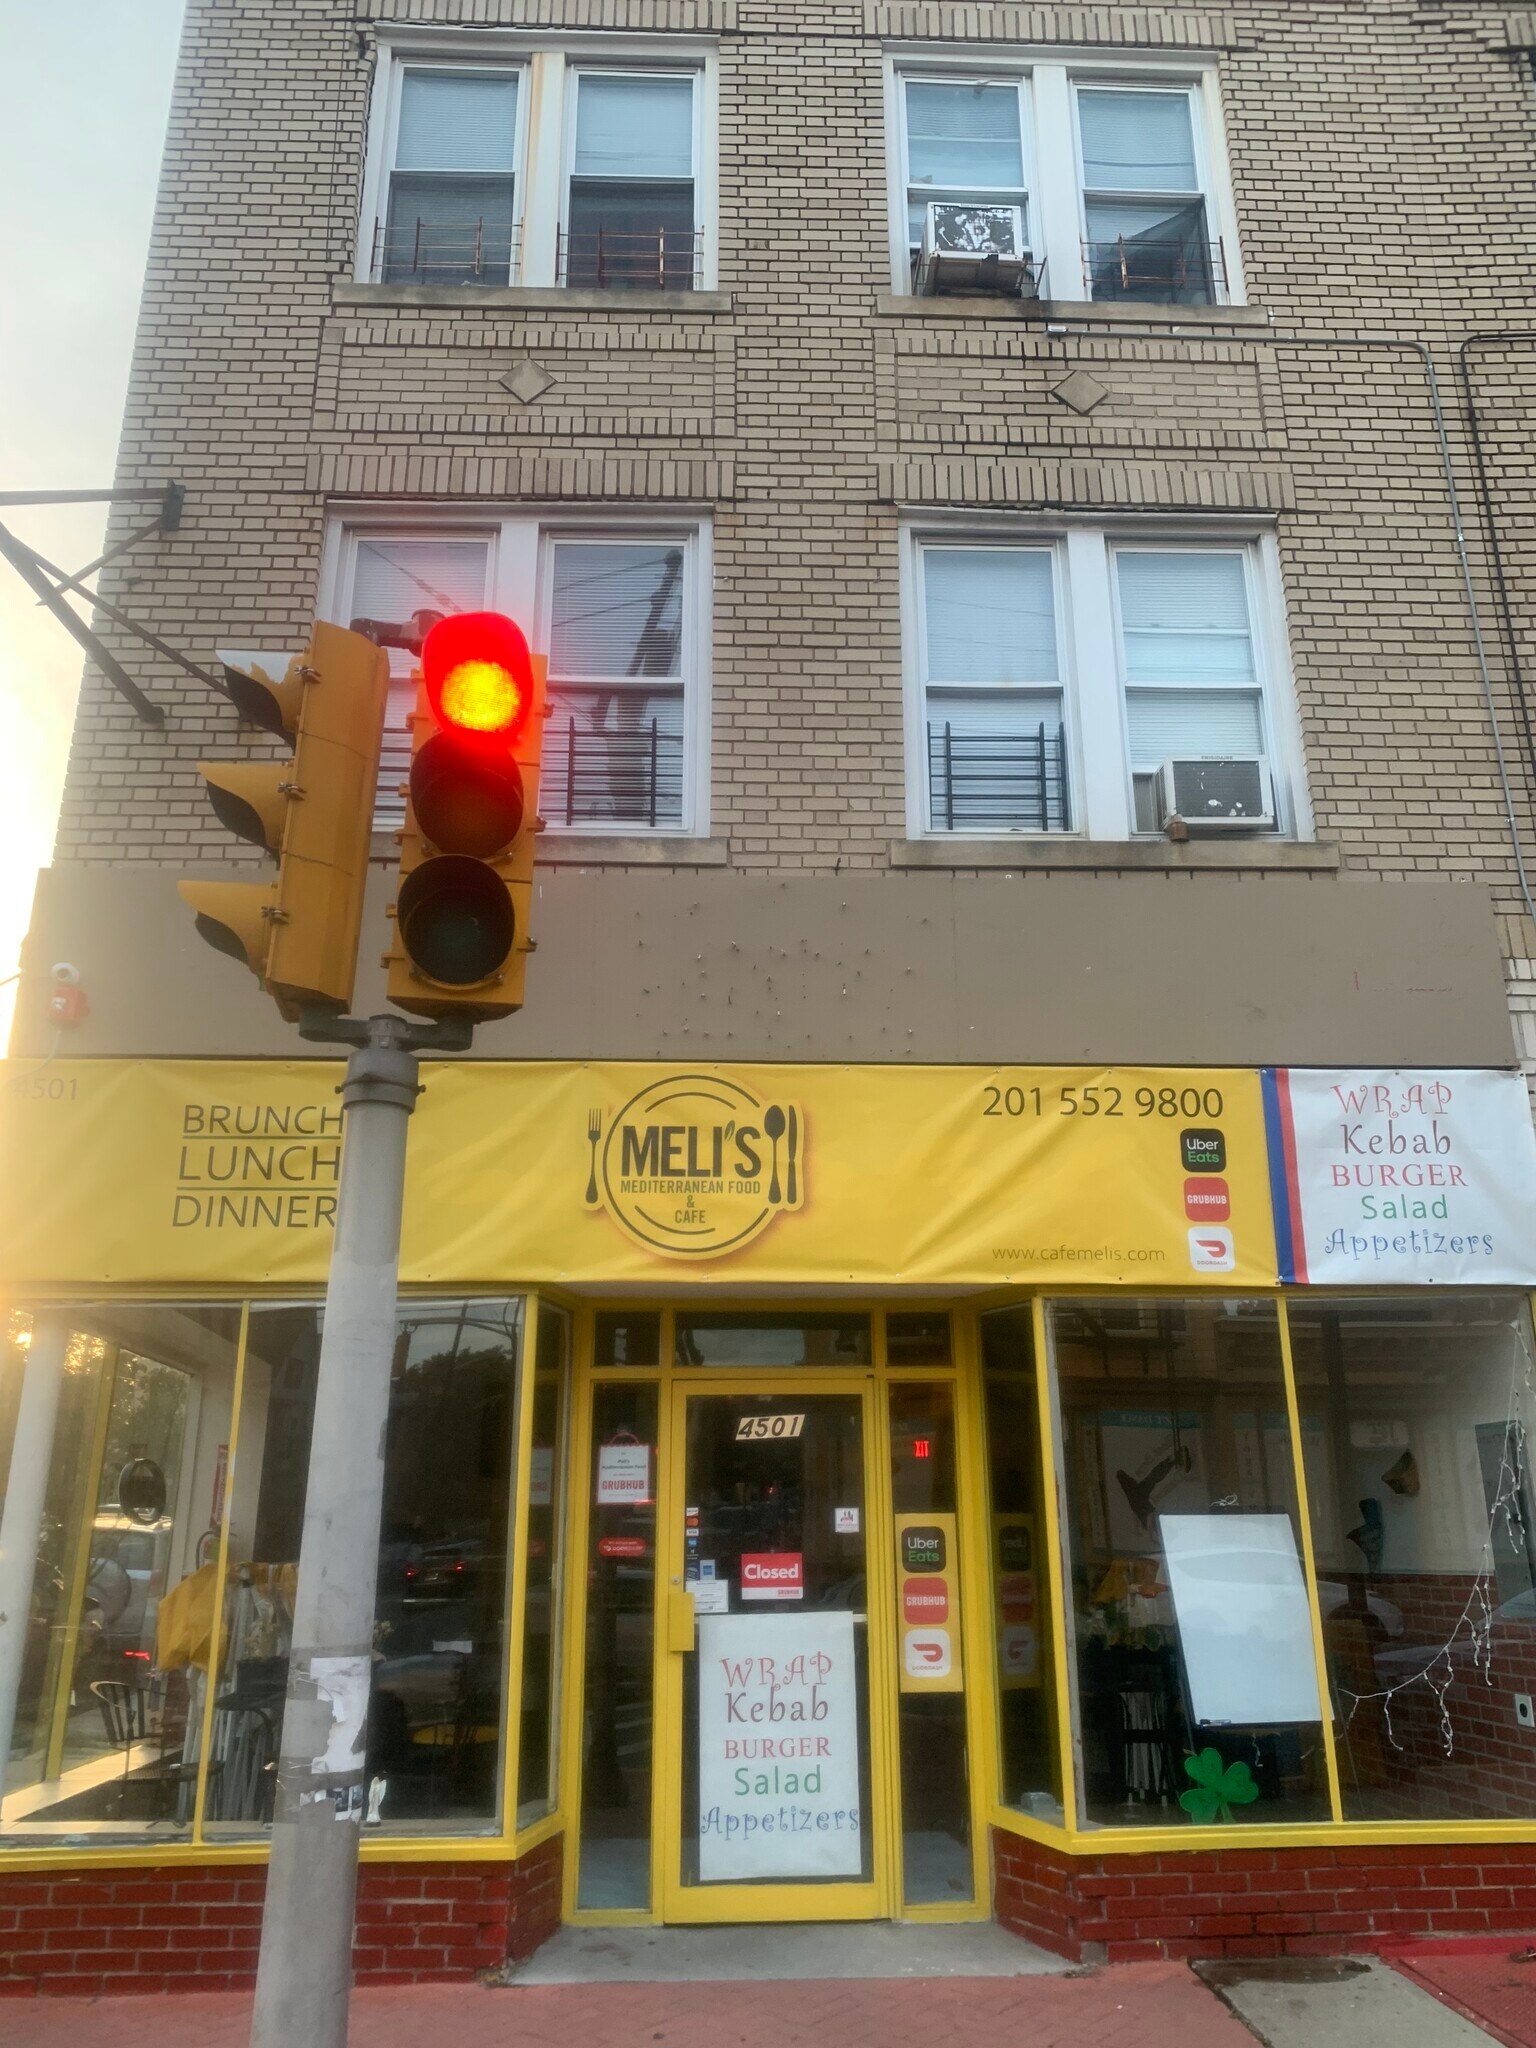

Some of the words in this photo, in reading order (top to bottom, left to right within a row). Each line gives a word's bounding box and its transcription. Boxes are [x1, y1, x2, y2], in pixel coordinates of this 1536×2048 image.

[8, 1078, 78, 1100] 4501
[1330, 1081, 1453, 1119] WRAP
[983, 1086, 1041, 1116] 201
[1060, 1087, 1123, 1117] 552
[1135, 1088, 1224, 1118] 9800
[183, 1104, 345, 1134] BRUNCH
[1186, 1138, 1219, 1150] Uber
[1340, 1120, 1451, 1154] Kebab
[620, 1120, 762, 1178] MELI'S
[1187, 1151, 1220, 1163] Eats
[179, 1145, 341, 1181] LUNCH
[1330, 1163, 1469, 1187] BURGER
[620, 1180, 724, 1194] MEDITERRANEAN
[729, 1181, 761, 1194] FOOD
[686, 1195, 695, 1208] &
[1187, 1195, 1227, 1204] GRUBHUB
[1361, 1194, 1448, 1219] Salad
[172, 1195, 338, 1228] DINNER
[674, 1210, 706, 1224] CAFE
[992, 1244, 1165, 1261] www.cafemelis.com
[1324, 1228, 1494, 1260] Appetizers
[738, 1416, 798, 1437] 4501
[602, 1480, 645, 1490] GRUBHUB
[907, 1537, 939, 1549] Uber
[908, 1551, 940, 1562] Eats
[744, 1563, 799, 1580] Closed
[906, 1596, 946, 1606] GRUBHUB
[720, 1651, 832, 1691] WRAP
[724, 1686, 829, 1723] Kebab
[724, 1737, 832, 1759] BURGER
[734, 1764, 821, 1796] Salad
[700, 1805, 860, 1840] Appetizers
